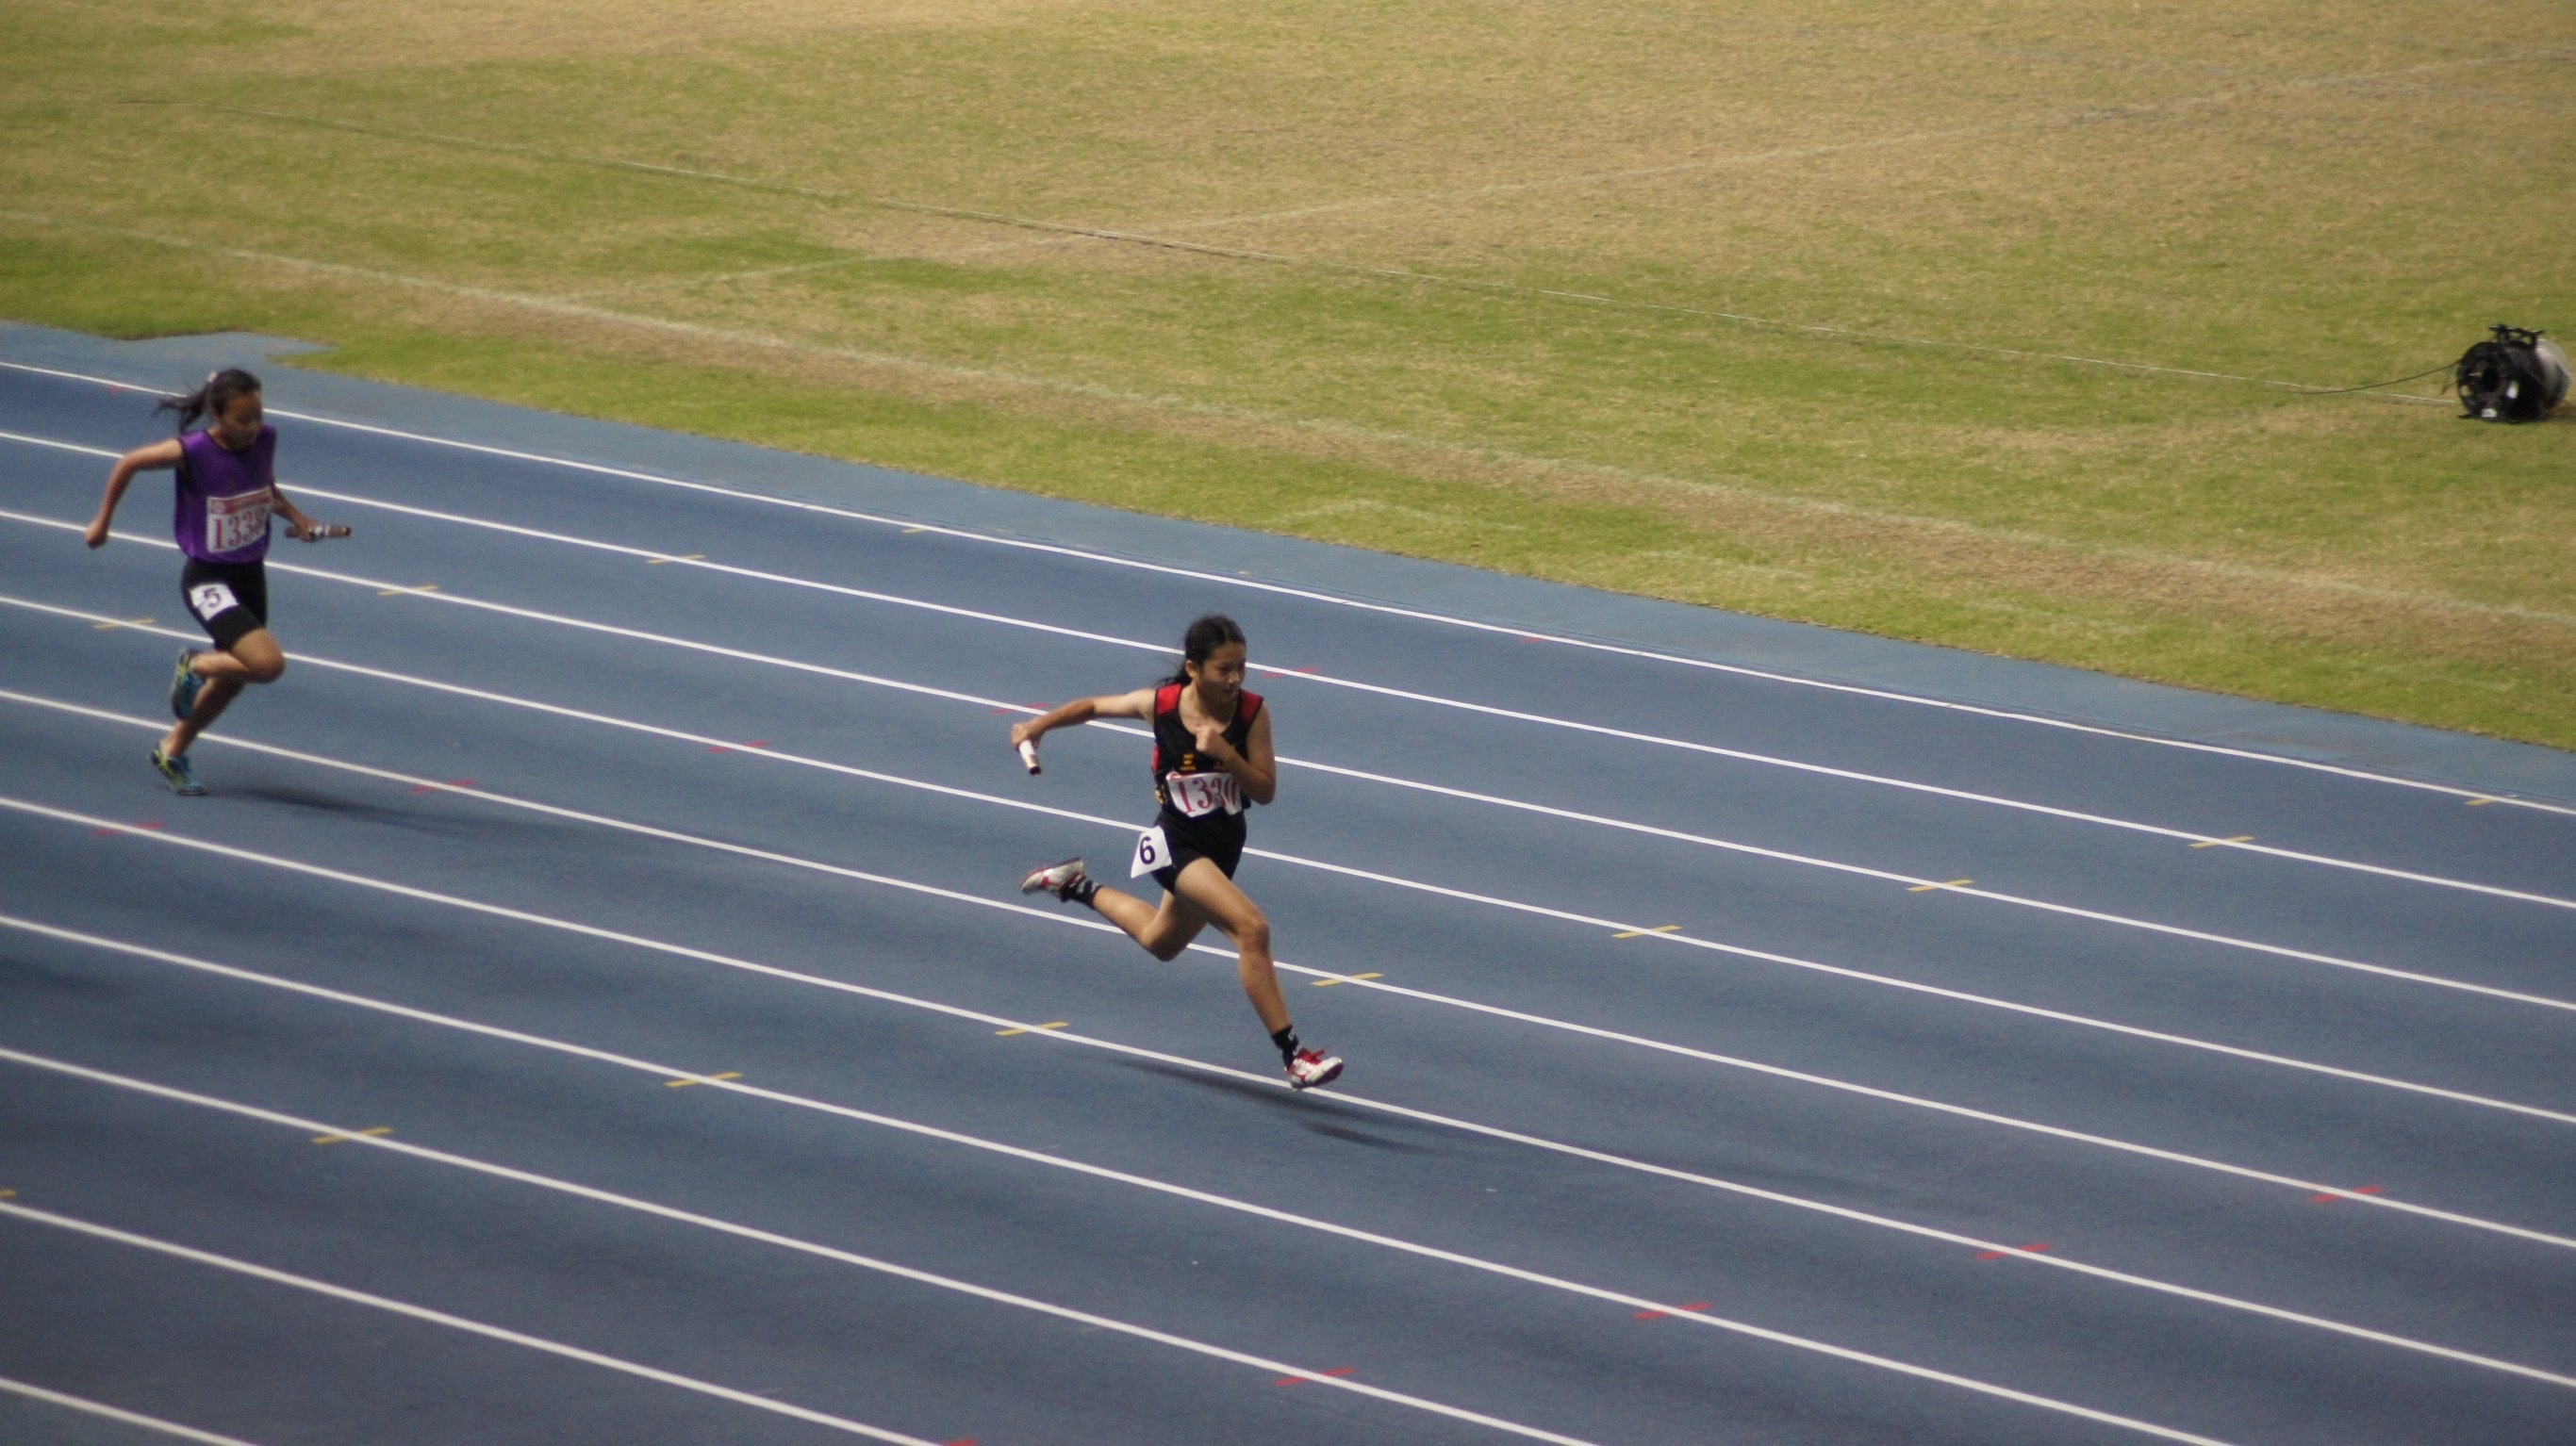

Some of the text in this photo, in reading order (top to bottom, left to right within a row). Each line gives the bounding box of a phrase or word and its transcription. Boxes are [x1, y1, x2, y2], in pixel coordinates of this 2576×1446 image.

[203, 587, 221, 608] 5
[1177, 778, 1238, 813] 1330
[1140, 836, 1156, 865] 6
